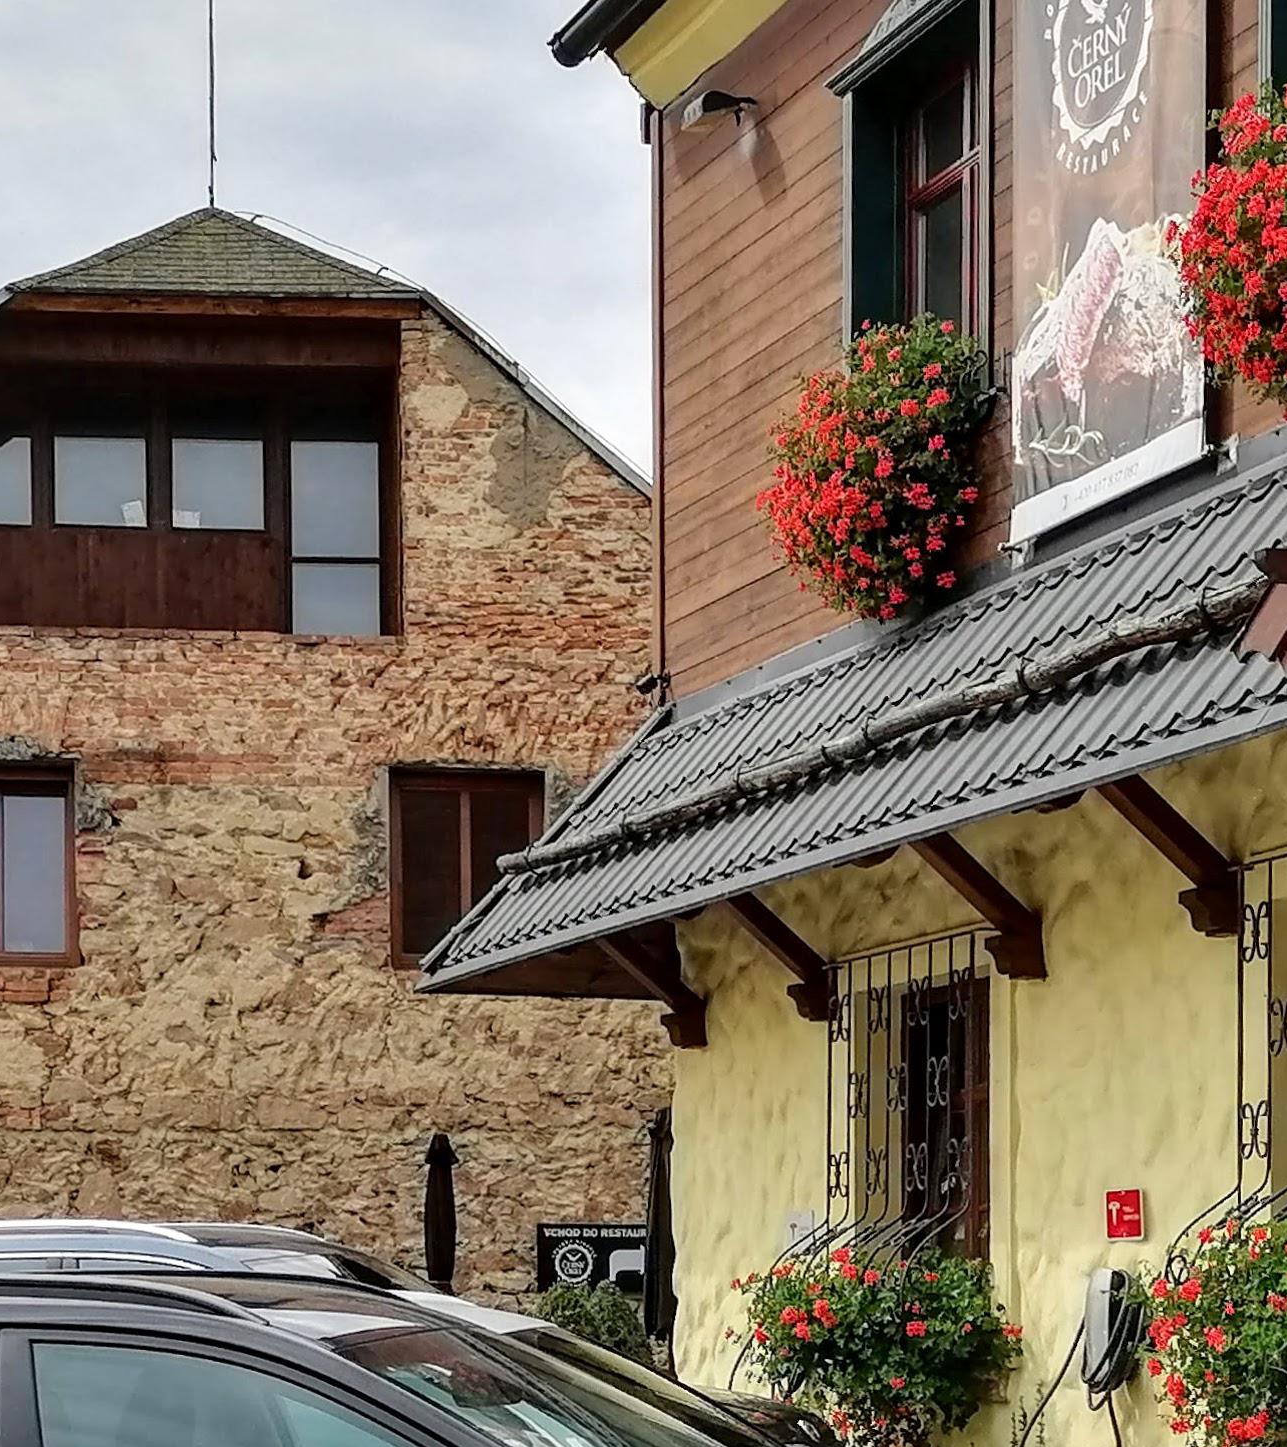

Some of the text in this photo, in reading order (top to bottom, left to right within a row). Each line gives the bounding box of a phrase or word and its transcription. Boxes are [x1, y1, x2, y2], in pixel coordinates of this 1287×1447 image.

[1068, 2, 1132, 78] ČERNÝ
[1075, 50, 1127, 108] OREL
[1056, 91, 1148, 174] RESTAURACE
[543, 1227, 581, 1238] VCHOD
[583, 1227, 598, 1238] DO
